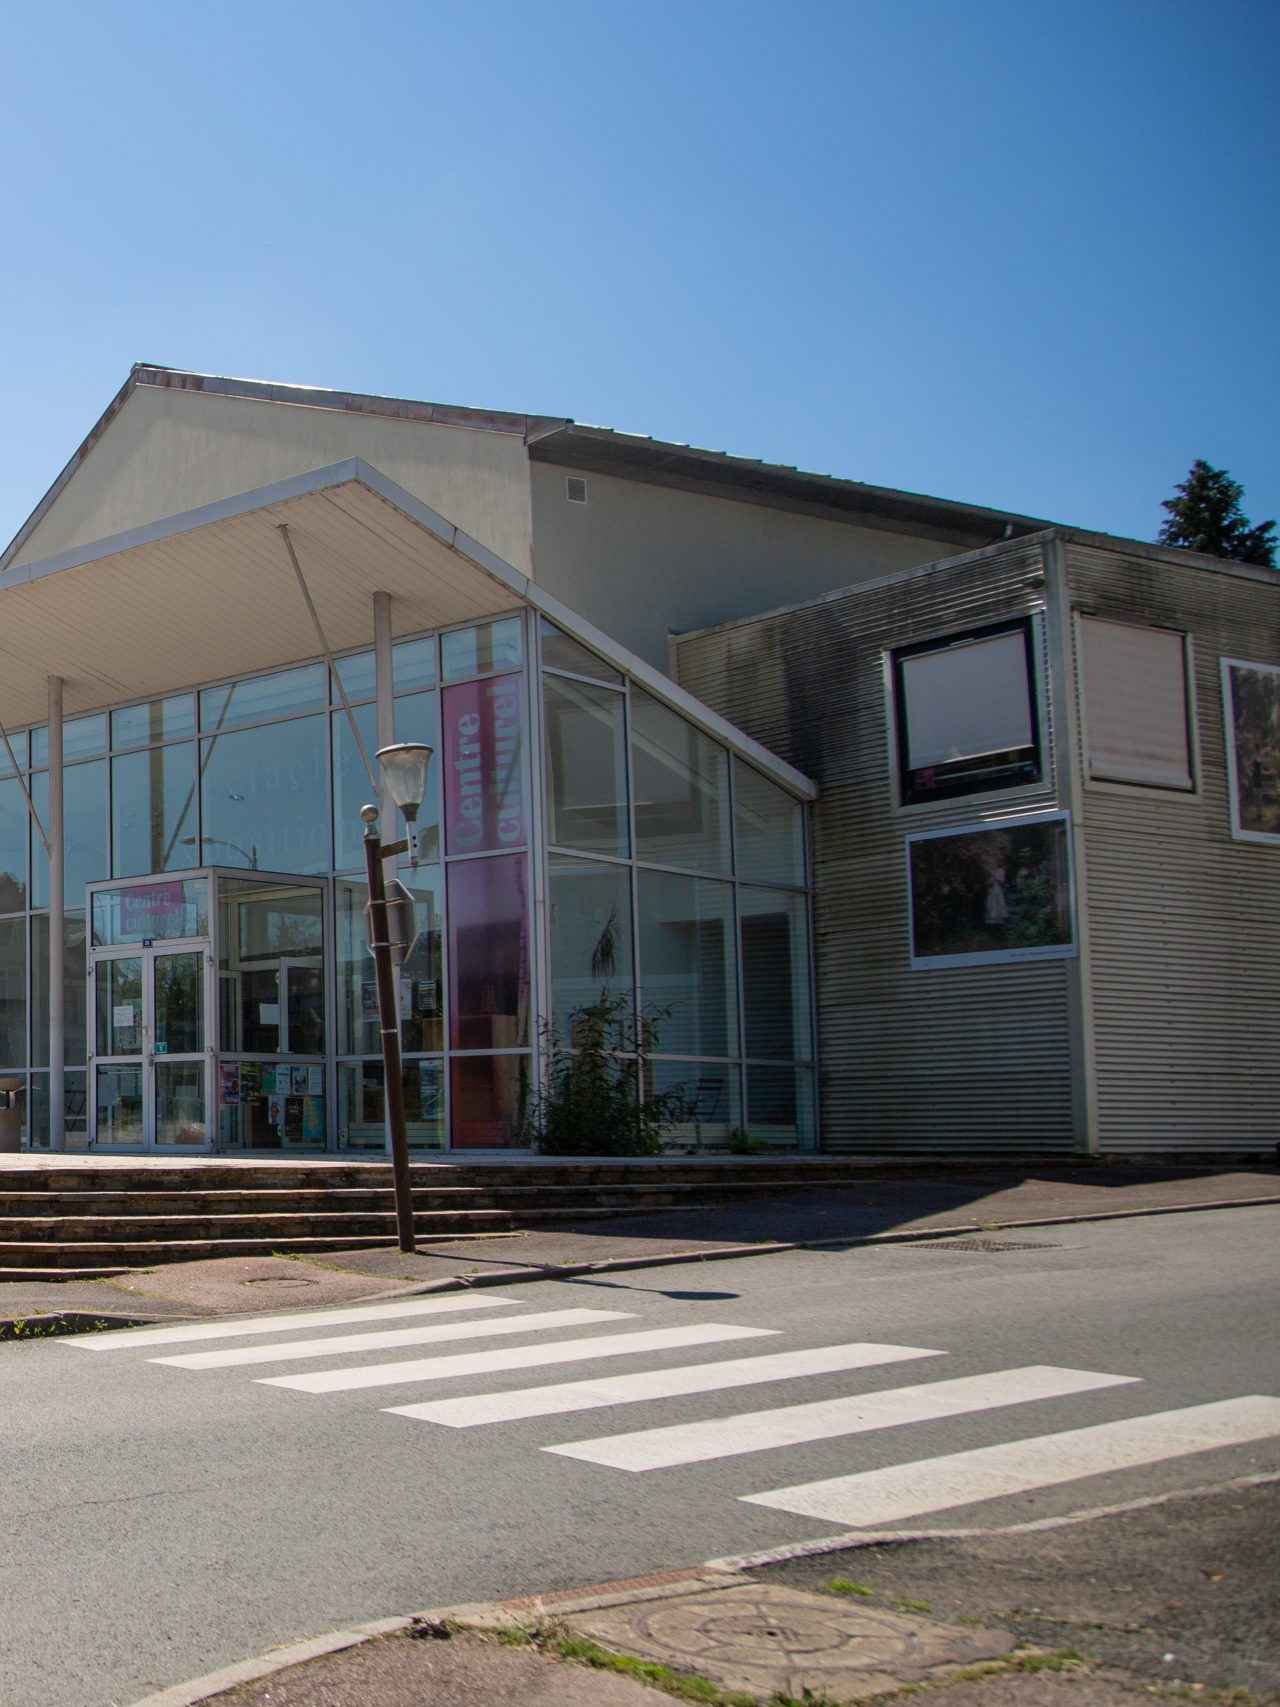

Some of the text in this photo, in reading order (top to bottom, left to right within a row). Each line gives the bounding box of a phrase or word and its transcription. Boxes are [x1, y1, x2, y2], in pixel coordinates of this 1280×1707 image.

[453, 711, 483, 849] Centre
[486, 683, 520, 842] culturel
[124, 891, 171, 911] Centre
[125, 909, 179, 931] culturel
